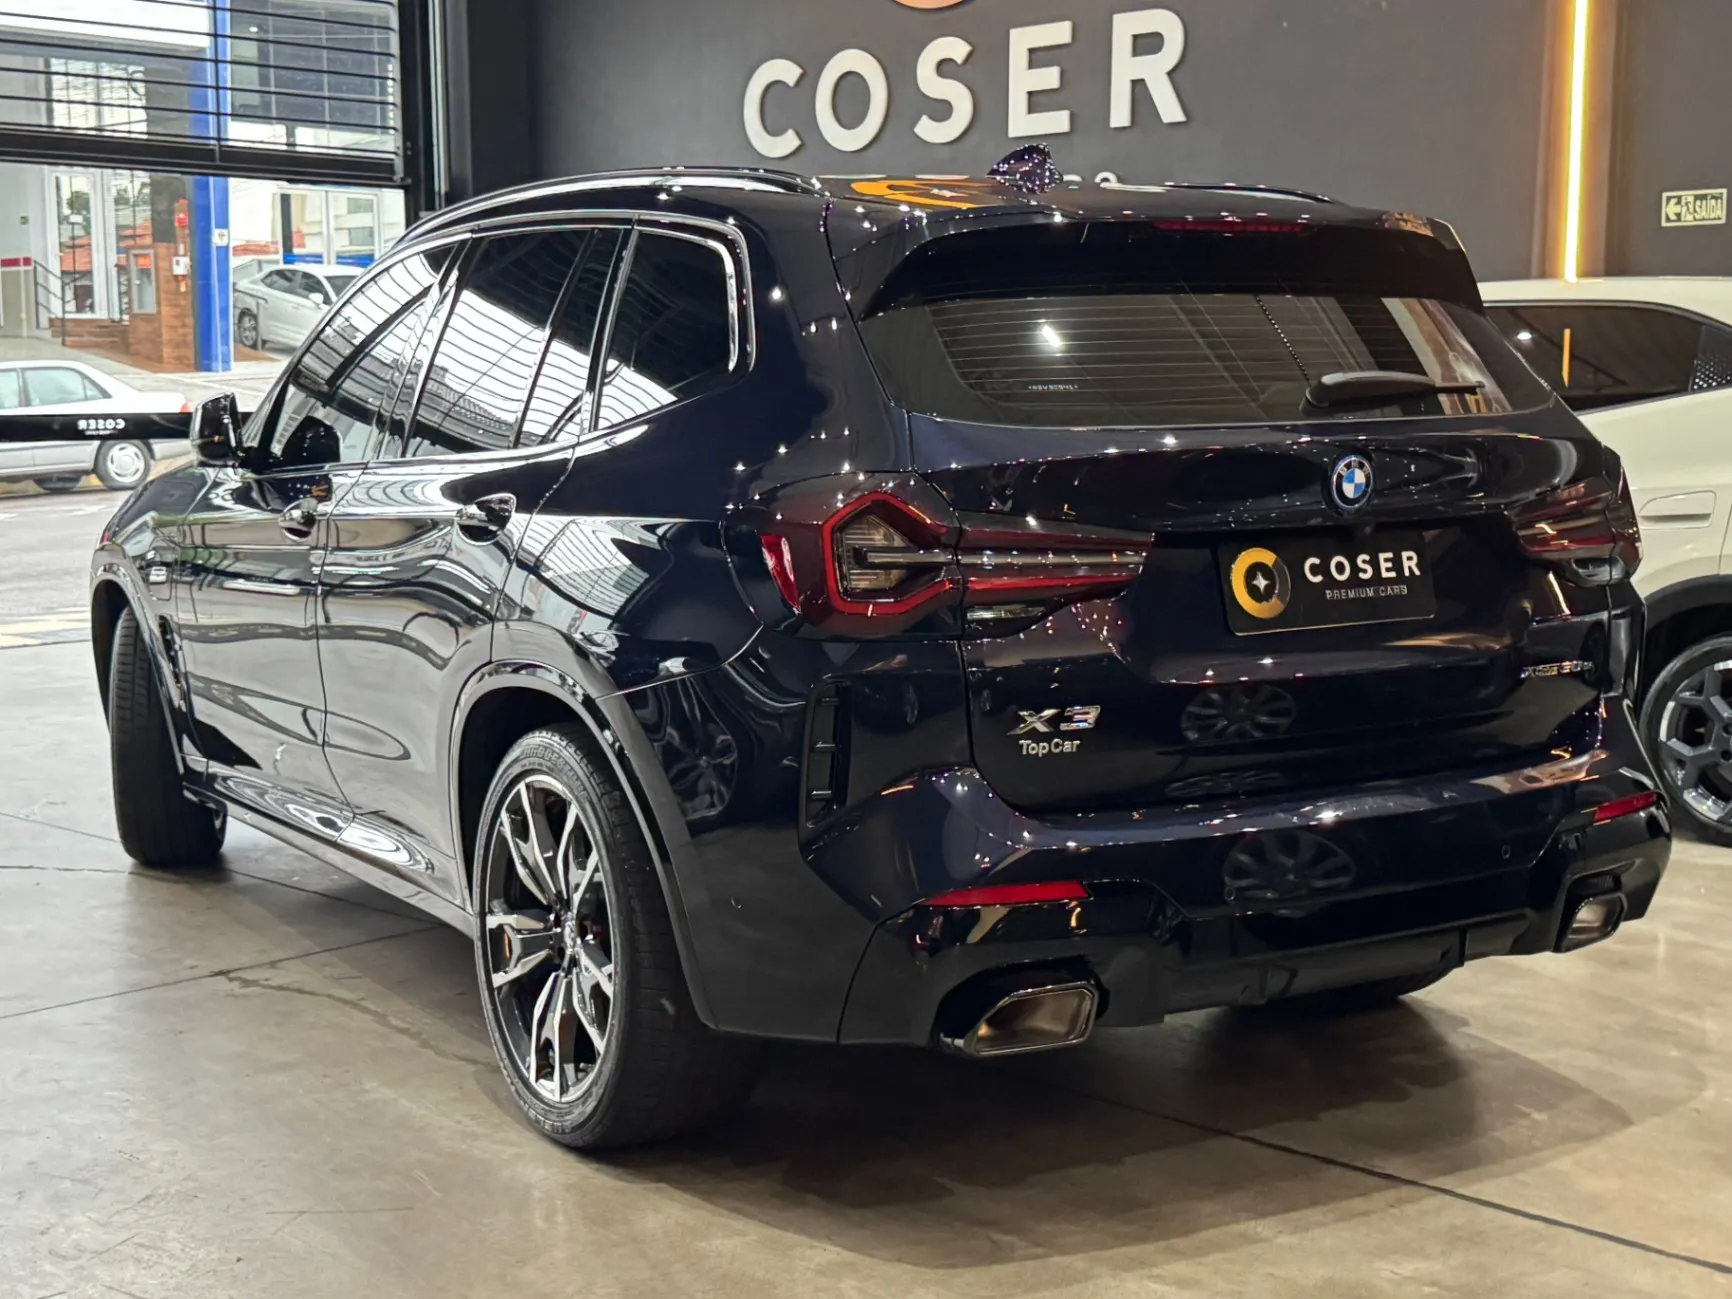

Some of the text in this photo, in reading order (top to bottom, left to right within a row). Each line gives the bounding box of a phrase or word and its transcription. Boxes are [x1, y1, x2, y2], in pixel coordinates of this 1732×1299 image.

[743, 8, 1187, 157] COSER
[1695, 195, 1722, 220] SAÍDA
[1304, 550, 1421, 583] COSER
[1325, 589, 1374, 600] PREMIUM
[1006, 705, 1101, 736] X3
